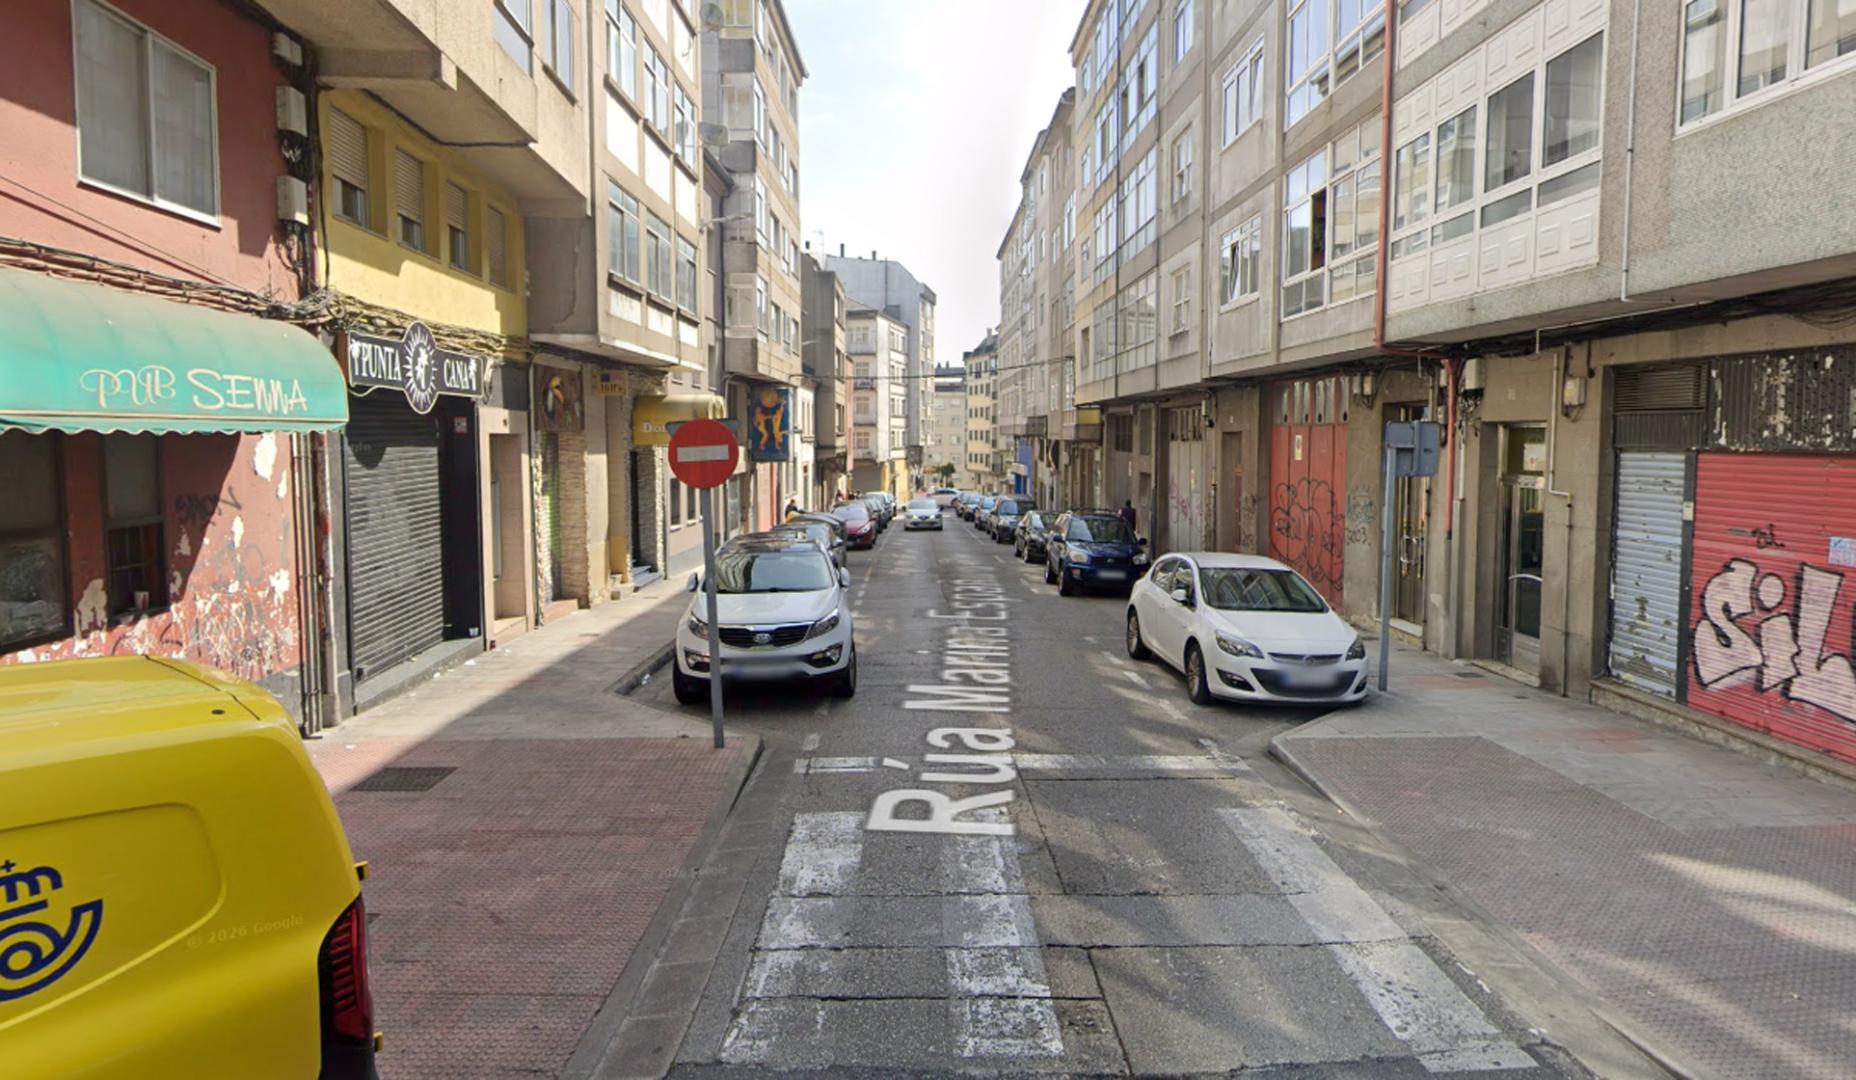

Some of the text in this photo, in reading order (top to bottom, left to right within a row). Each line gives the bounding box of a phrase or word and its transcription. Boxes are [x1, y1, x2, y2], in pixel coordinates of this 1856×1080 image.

[80, 365, 308, 415] PUB SENNA
[360, 341, 470, 391] PUNTA CANA
